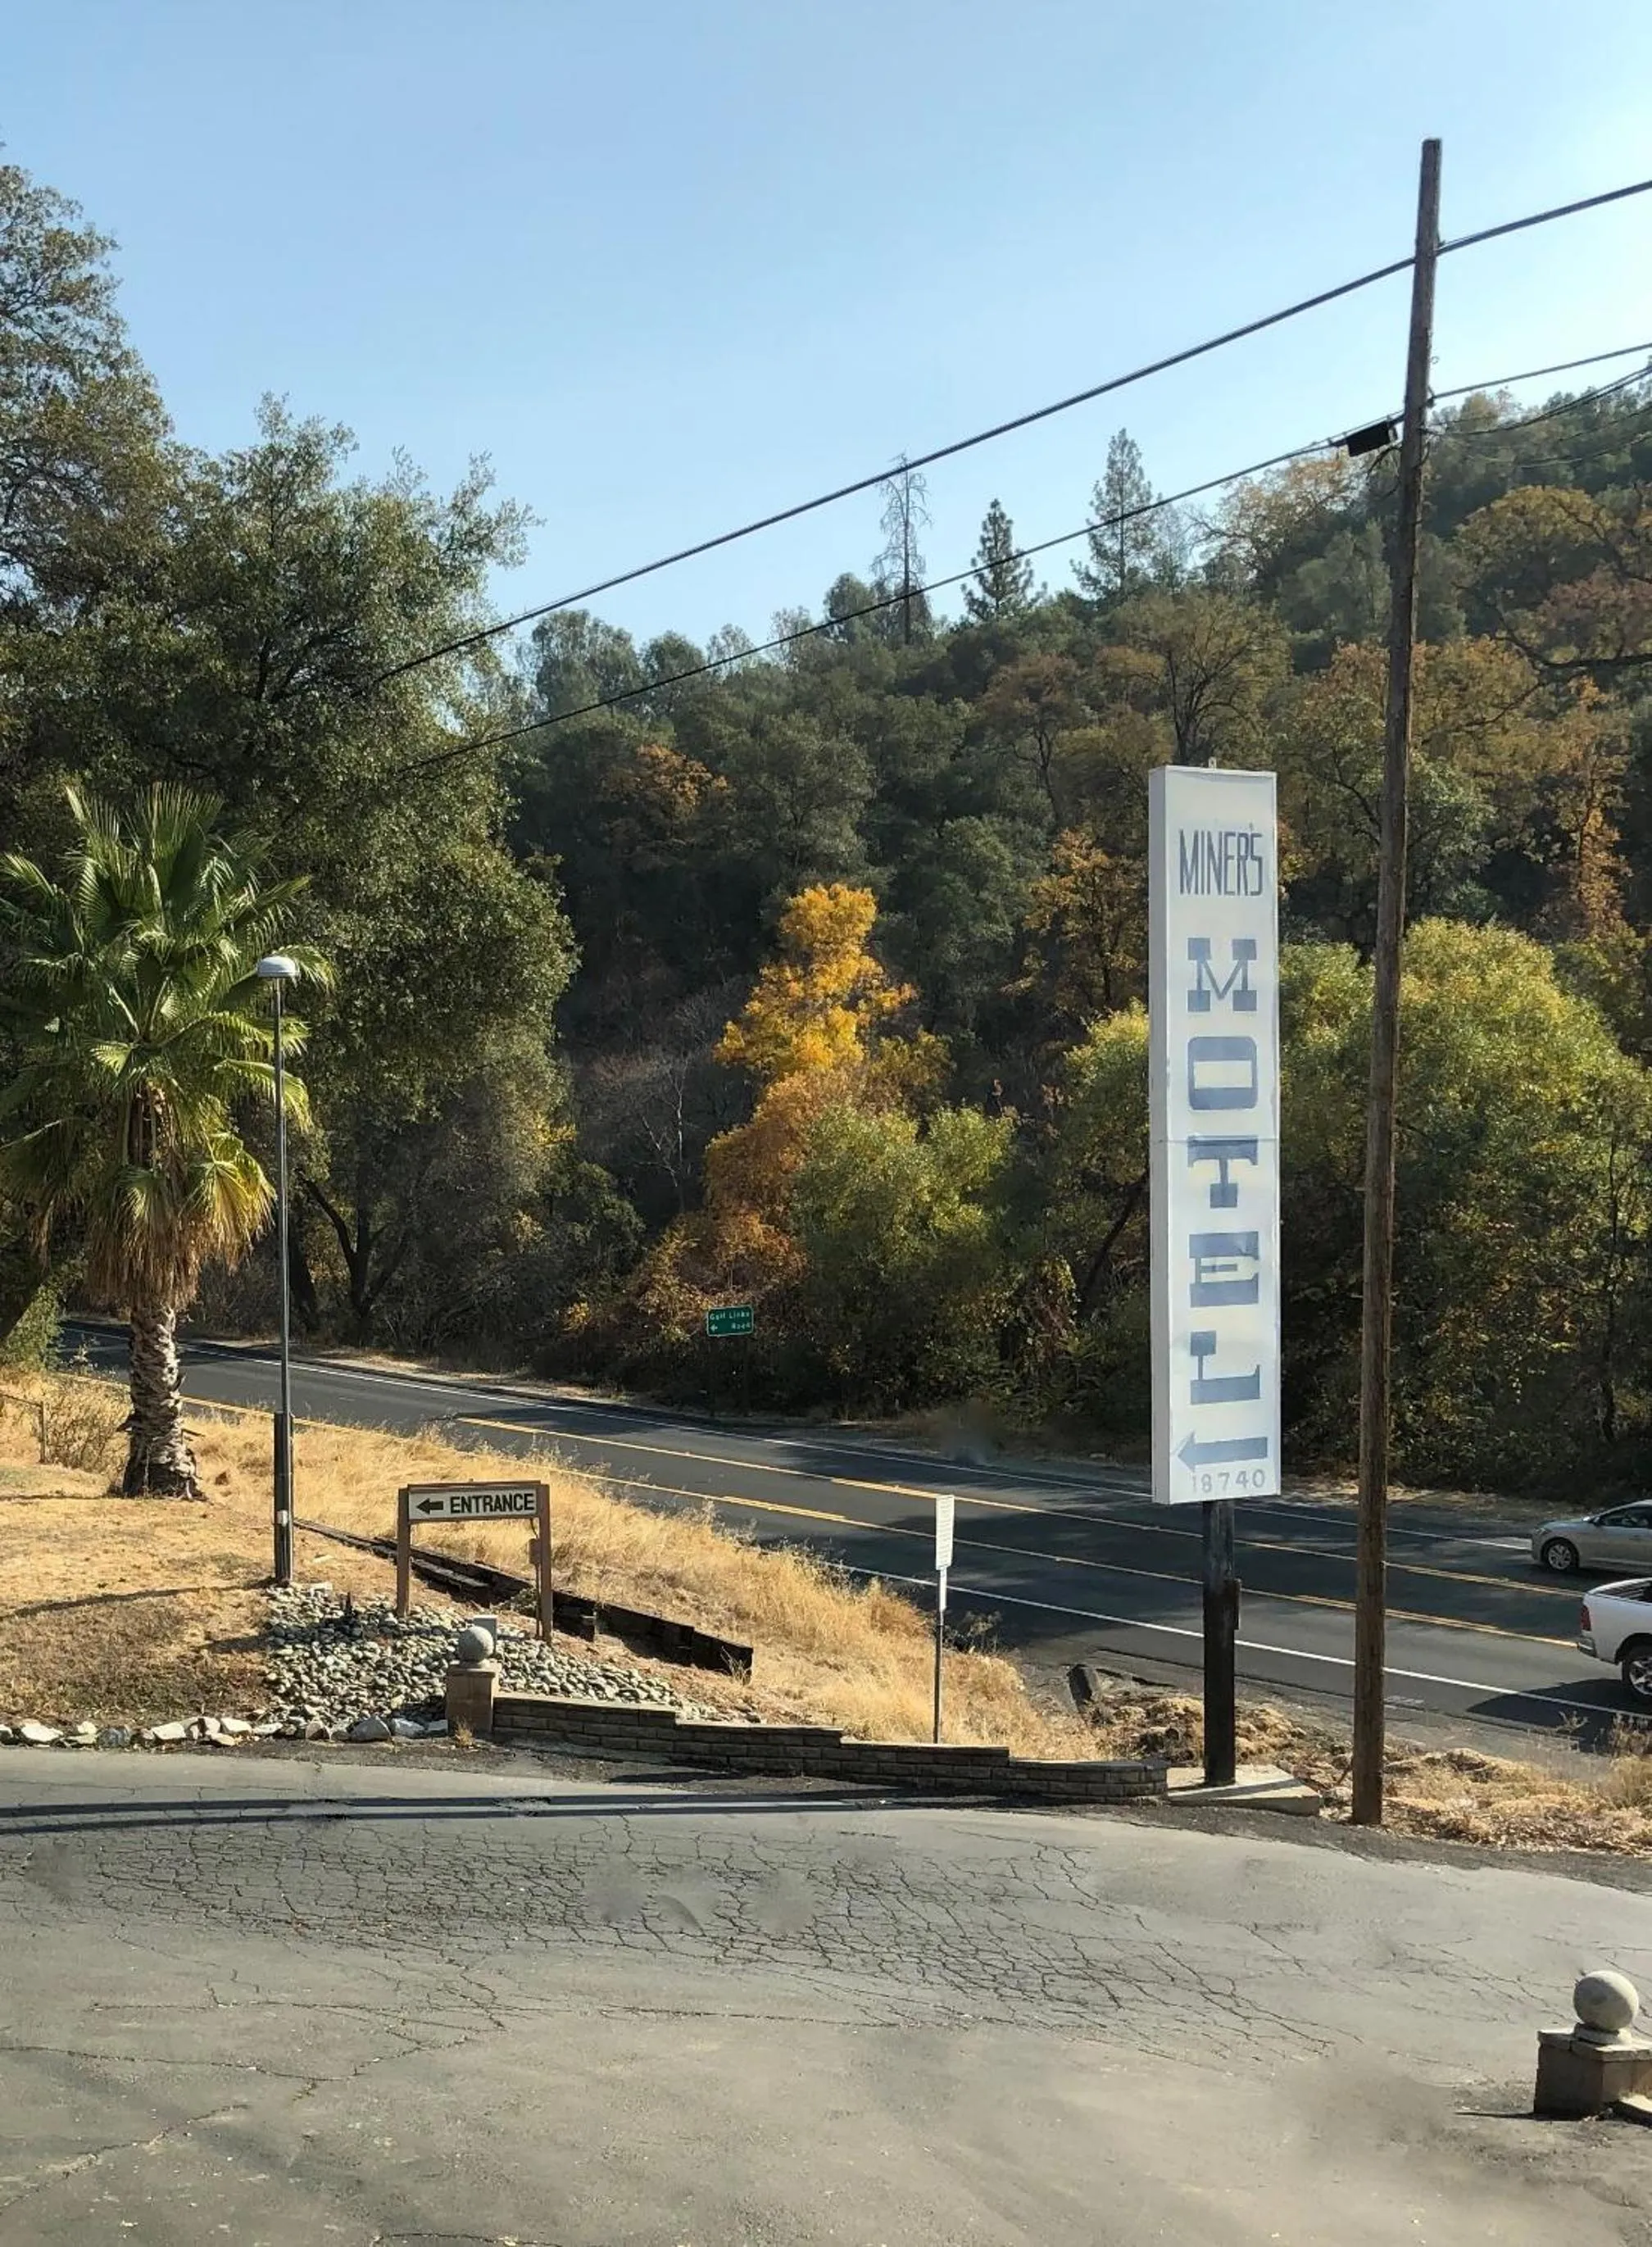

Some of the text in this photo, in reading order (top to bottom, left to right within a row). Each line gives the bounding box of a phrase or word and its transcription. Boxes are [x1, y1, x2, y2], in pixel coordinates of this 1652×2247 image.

[1179, 823, 1264, 897] MINER'S
[1187, 937, 1260, 1405] MOTEL
[451, 1493, 534, 1514] ENTRANCE
[1191, 1469, 1266, 1493] 18740
